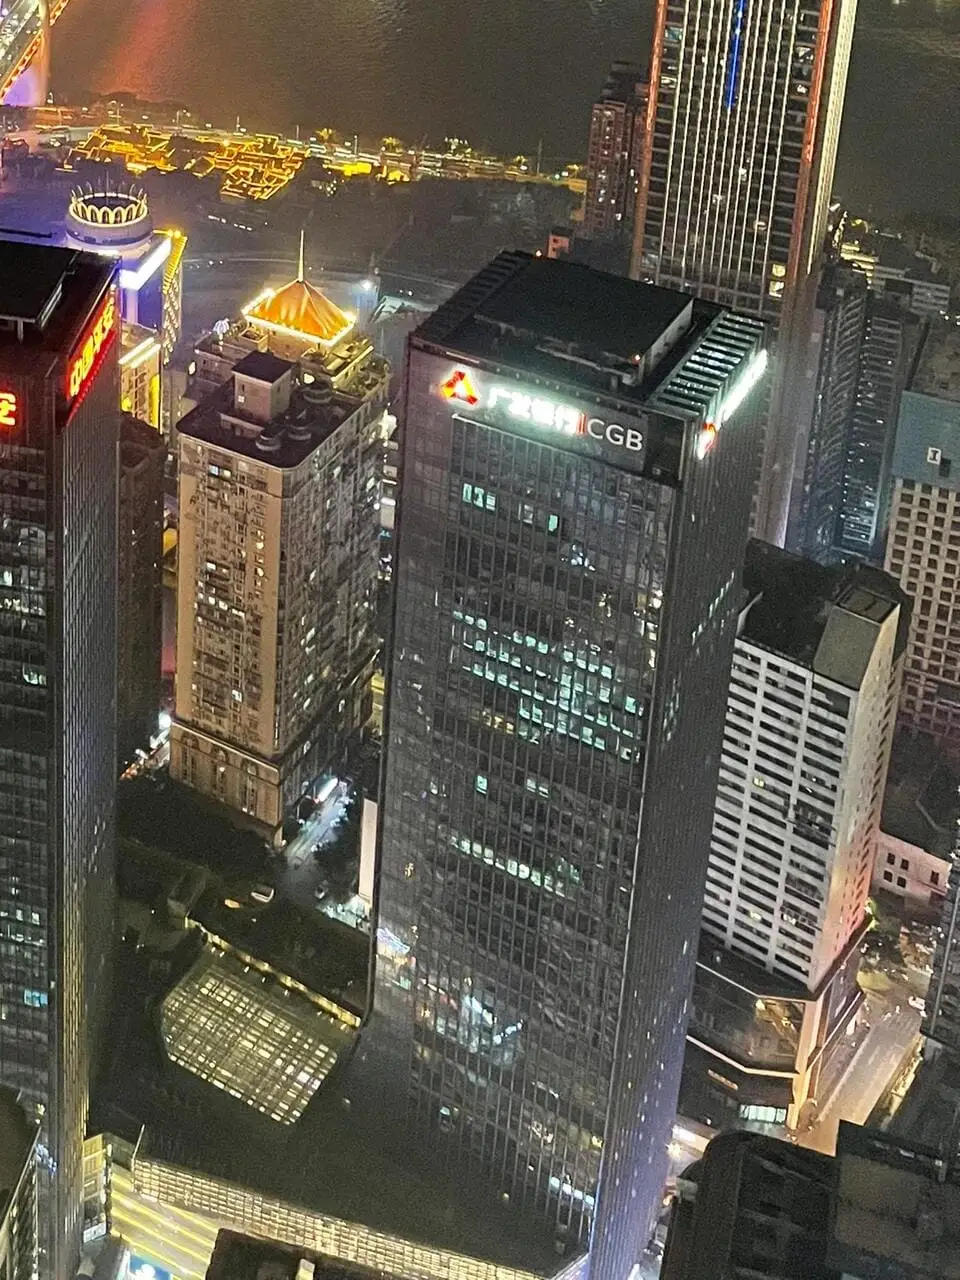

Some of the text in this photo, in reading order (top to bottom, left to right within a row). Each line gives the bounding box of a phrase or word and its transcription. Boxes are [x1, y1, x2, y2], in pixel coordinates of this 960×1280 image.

[487, 385, 644, 451] 广发银行 CGB
